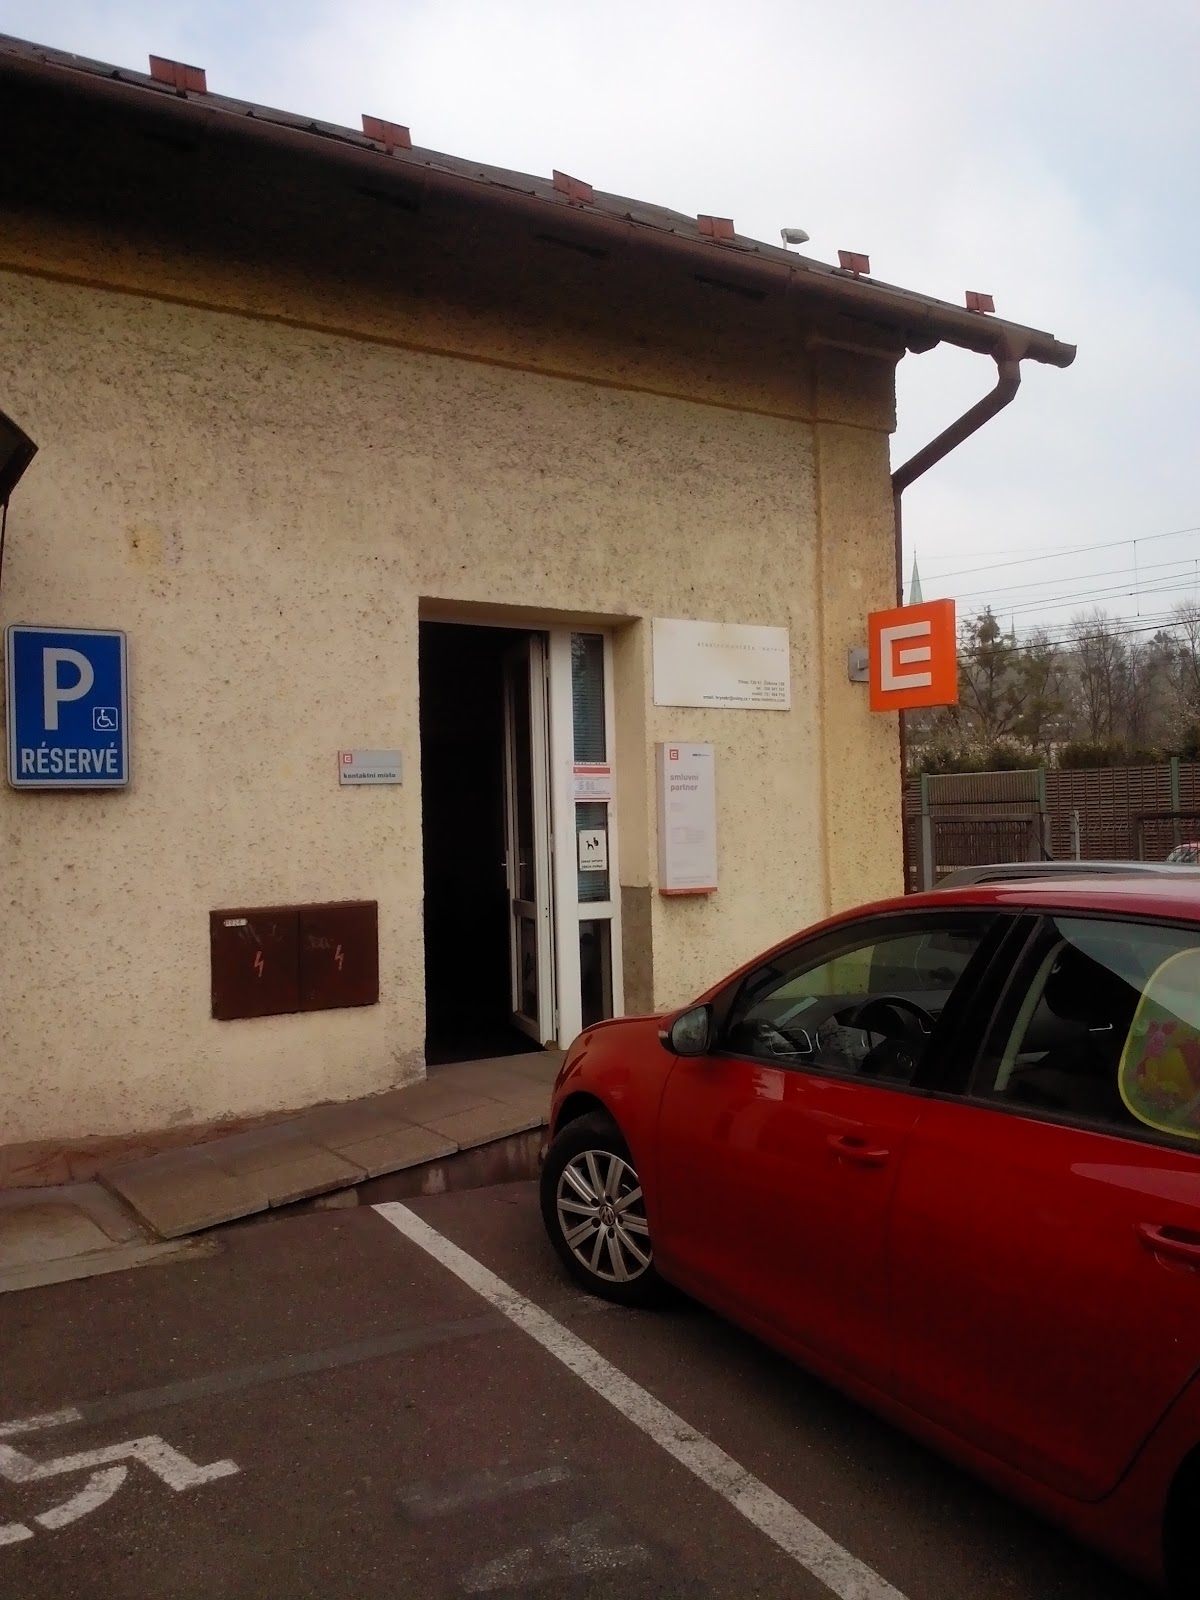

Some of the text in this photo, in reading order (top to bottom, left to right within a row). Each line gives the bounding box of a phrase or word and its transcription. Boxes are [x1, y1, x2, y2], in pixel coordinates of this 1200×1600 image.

[43, 647, 94, 731] P
[21, 741, 118, 773] RÉSERVÉ
[670, 784, 698, 792] partner
